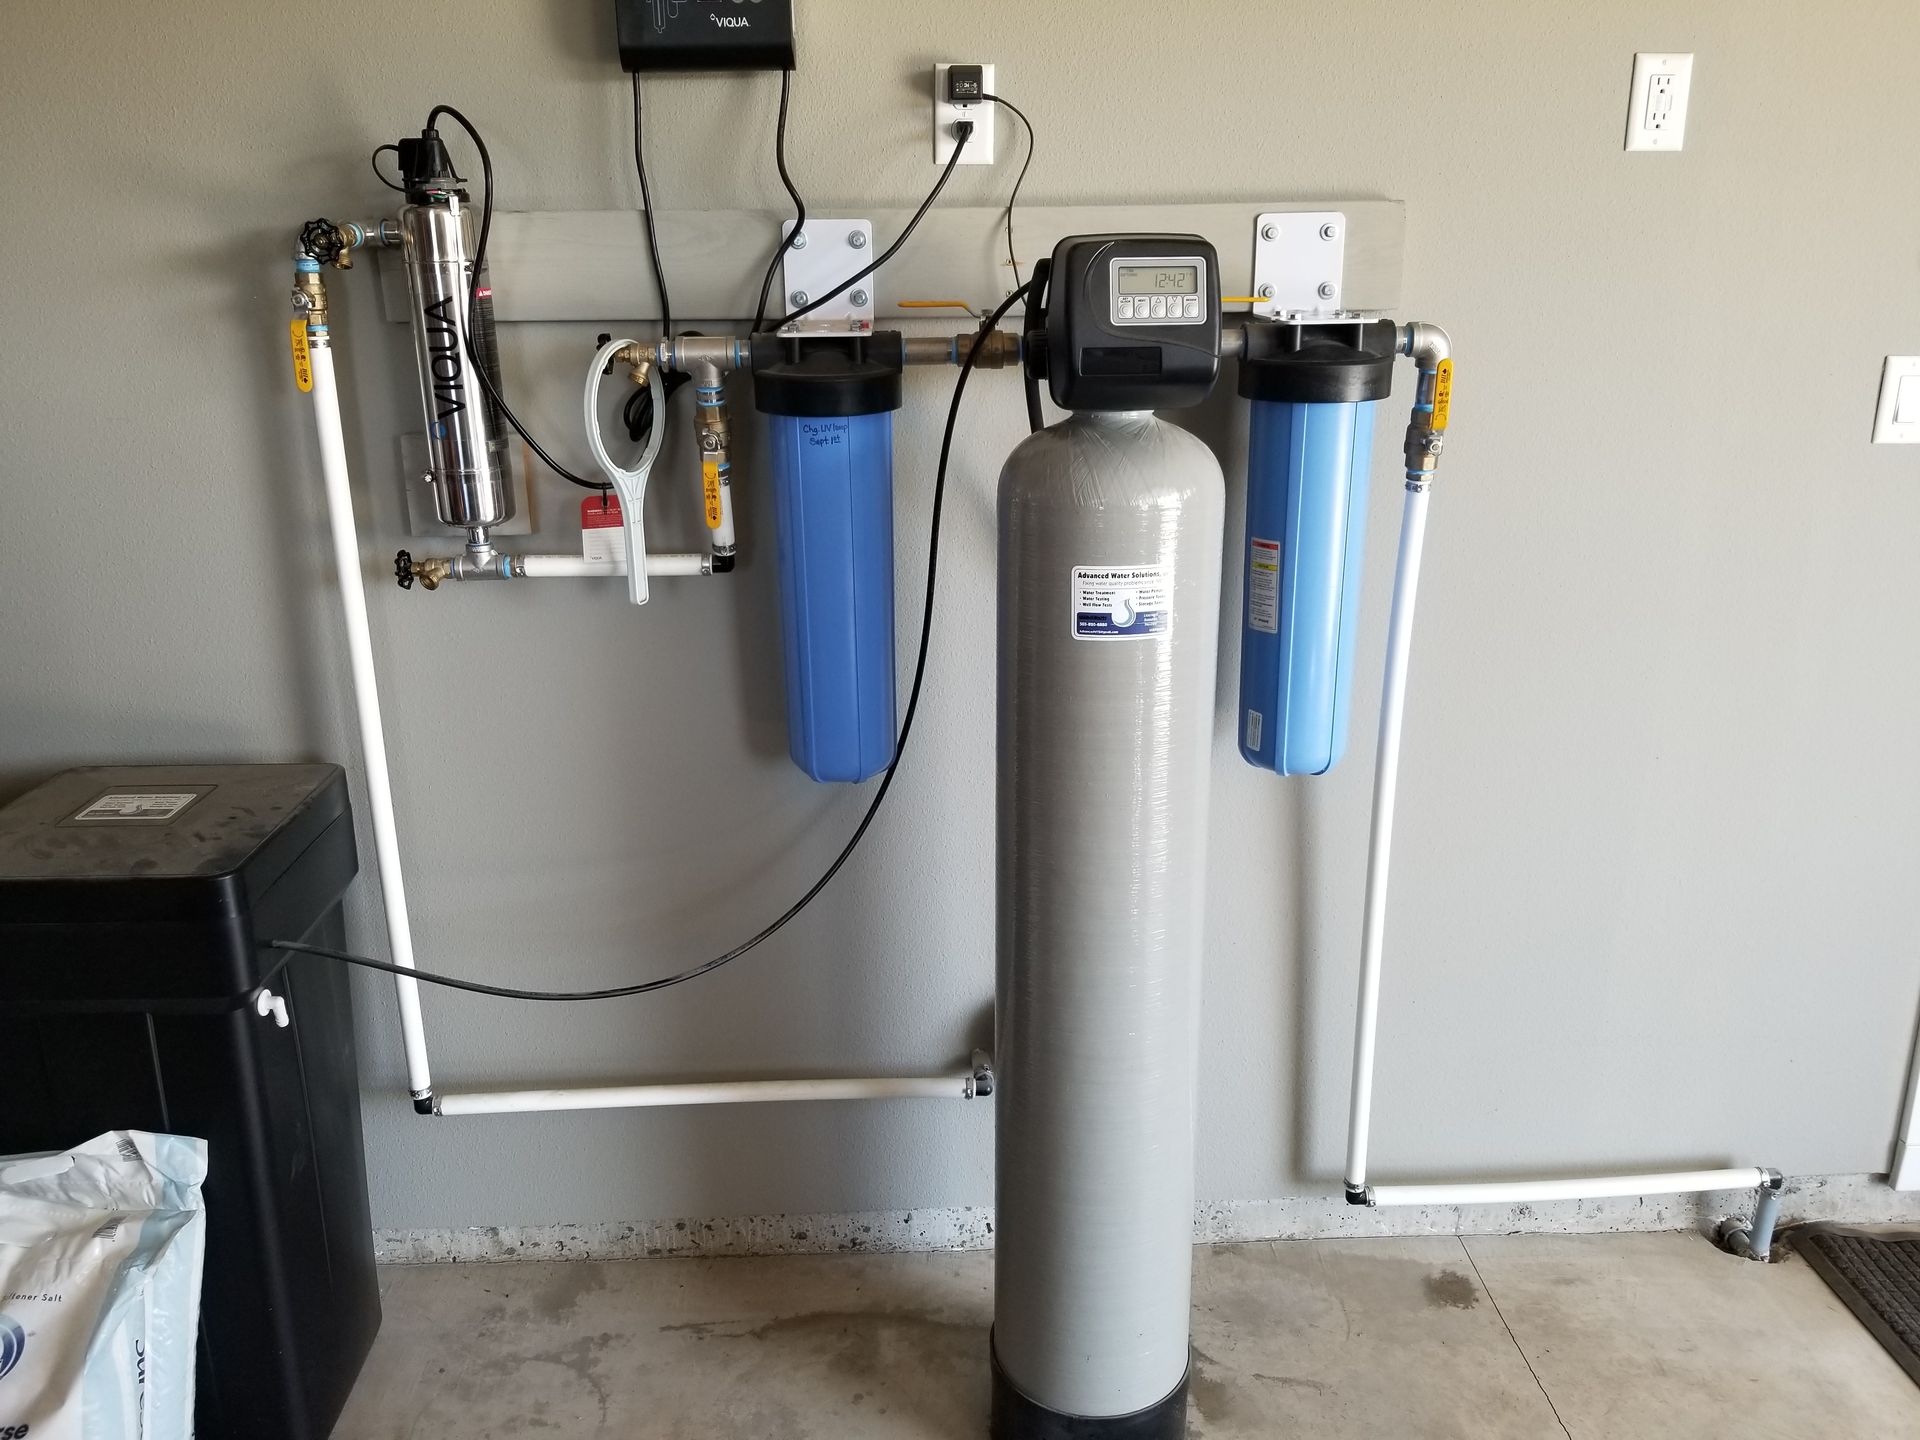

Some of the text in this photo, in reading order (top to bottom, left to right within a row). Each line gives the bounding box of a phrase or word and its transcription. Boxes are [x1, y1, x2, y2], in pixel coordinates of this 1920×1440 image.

[716, 17, 749, 27] VIQUA
[1155, 272, 1185, 288] 12:42
[424, 296, 466, 420] VIQUA
[41, 1294, 62, 1302] Salt
